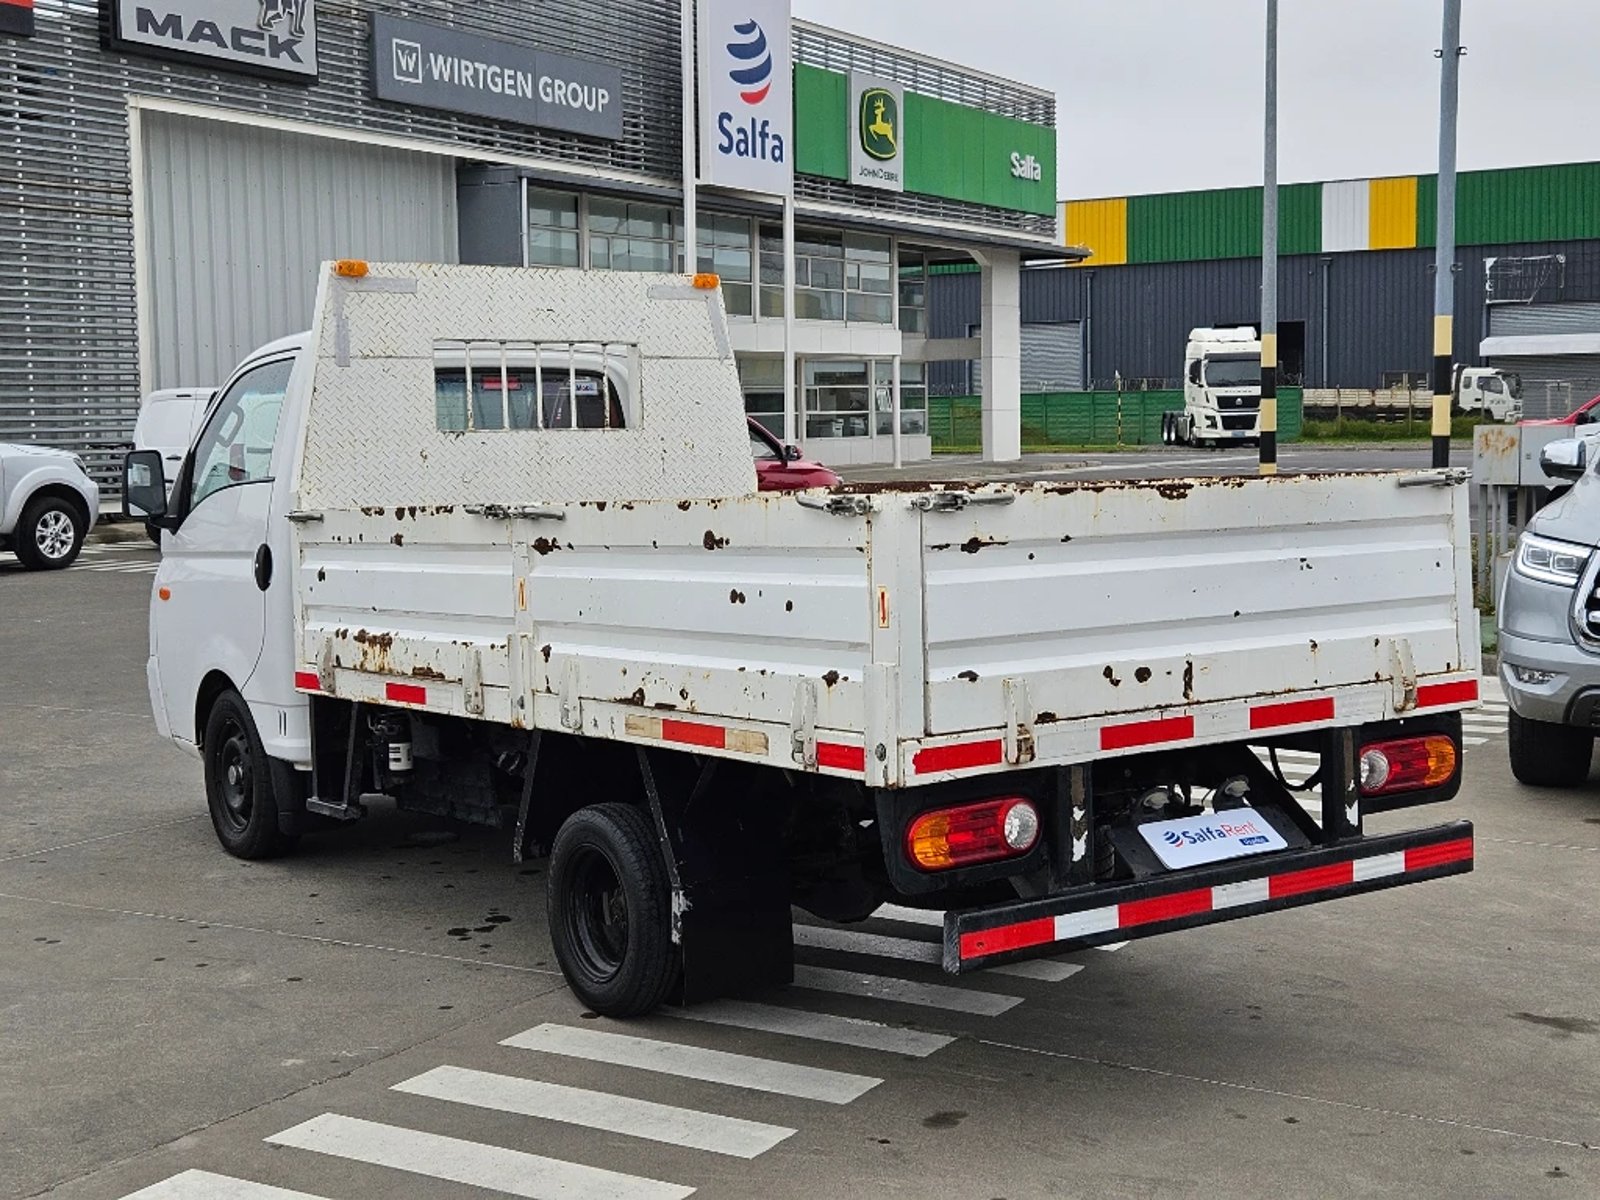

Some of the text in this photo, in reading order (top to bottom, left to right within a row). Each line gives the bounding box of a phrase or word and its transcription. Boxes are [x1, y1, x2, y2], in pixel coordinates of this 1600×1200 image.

[135, 7, 304, 64] MACK
[428, 52, 533, 99] WIRTGEN
[538, 75, 610, 113] GROUP
[718, 111, 784, 163] Salfa
[1010, 151, 1042, 181] Salfa
